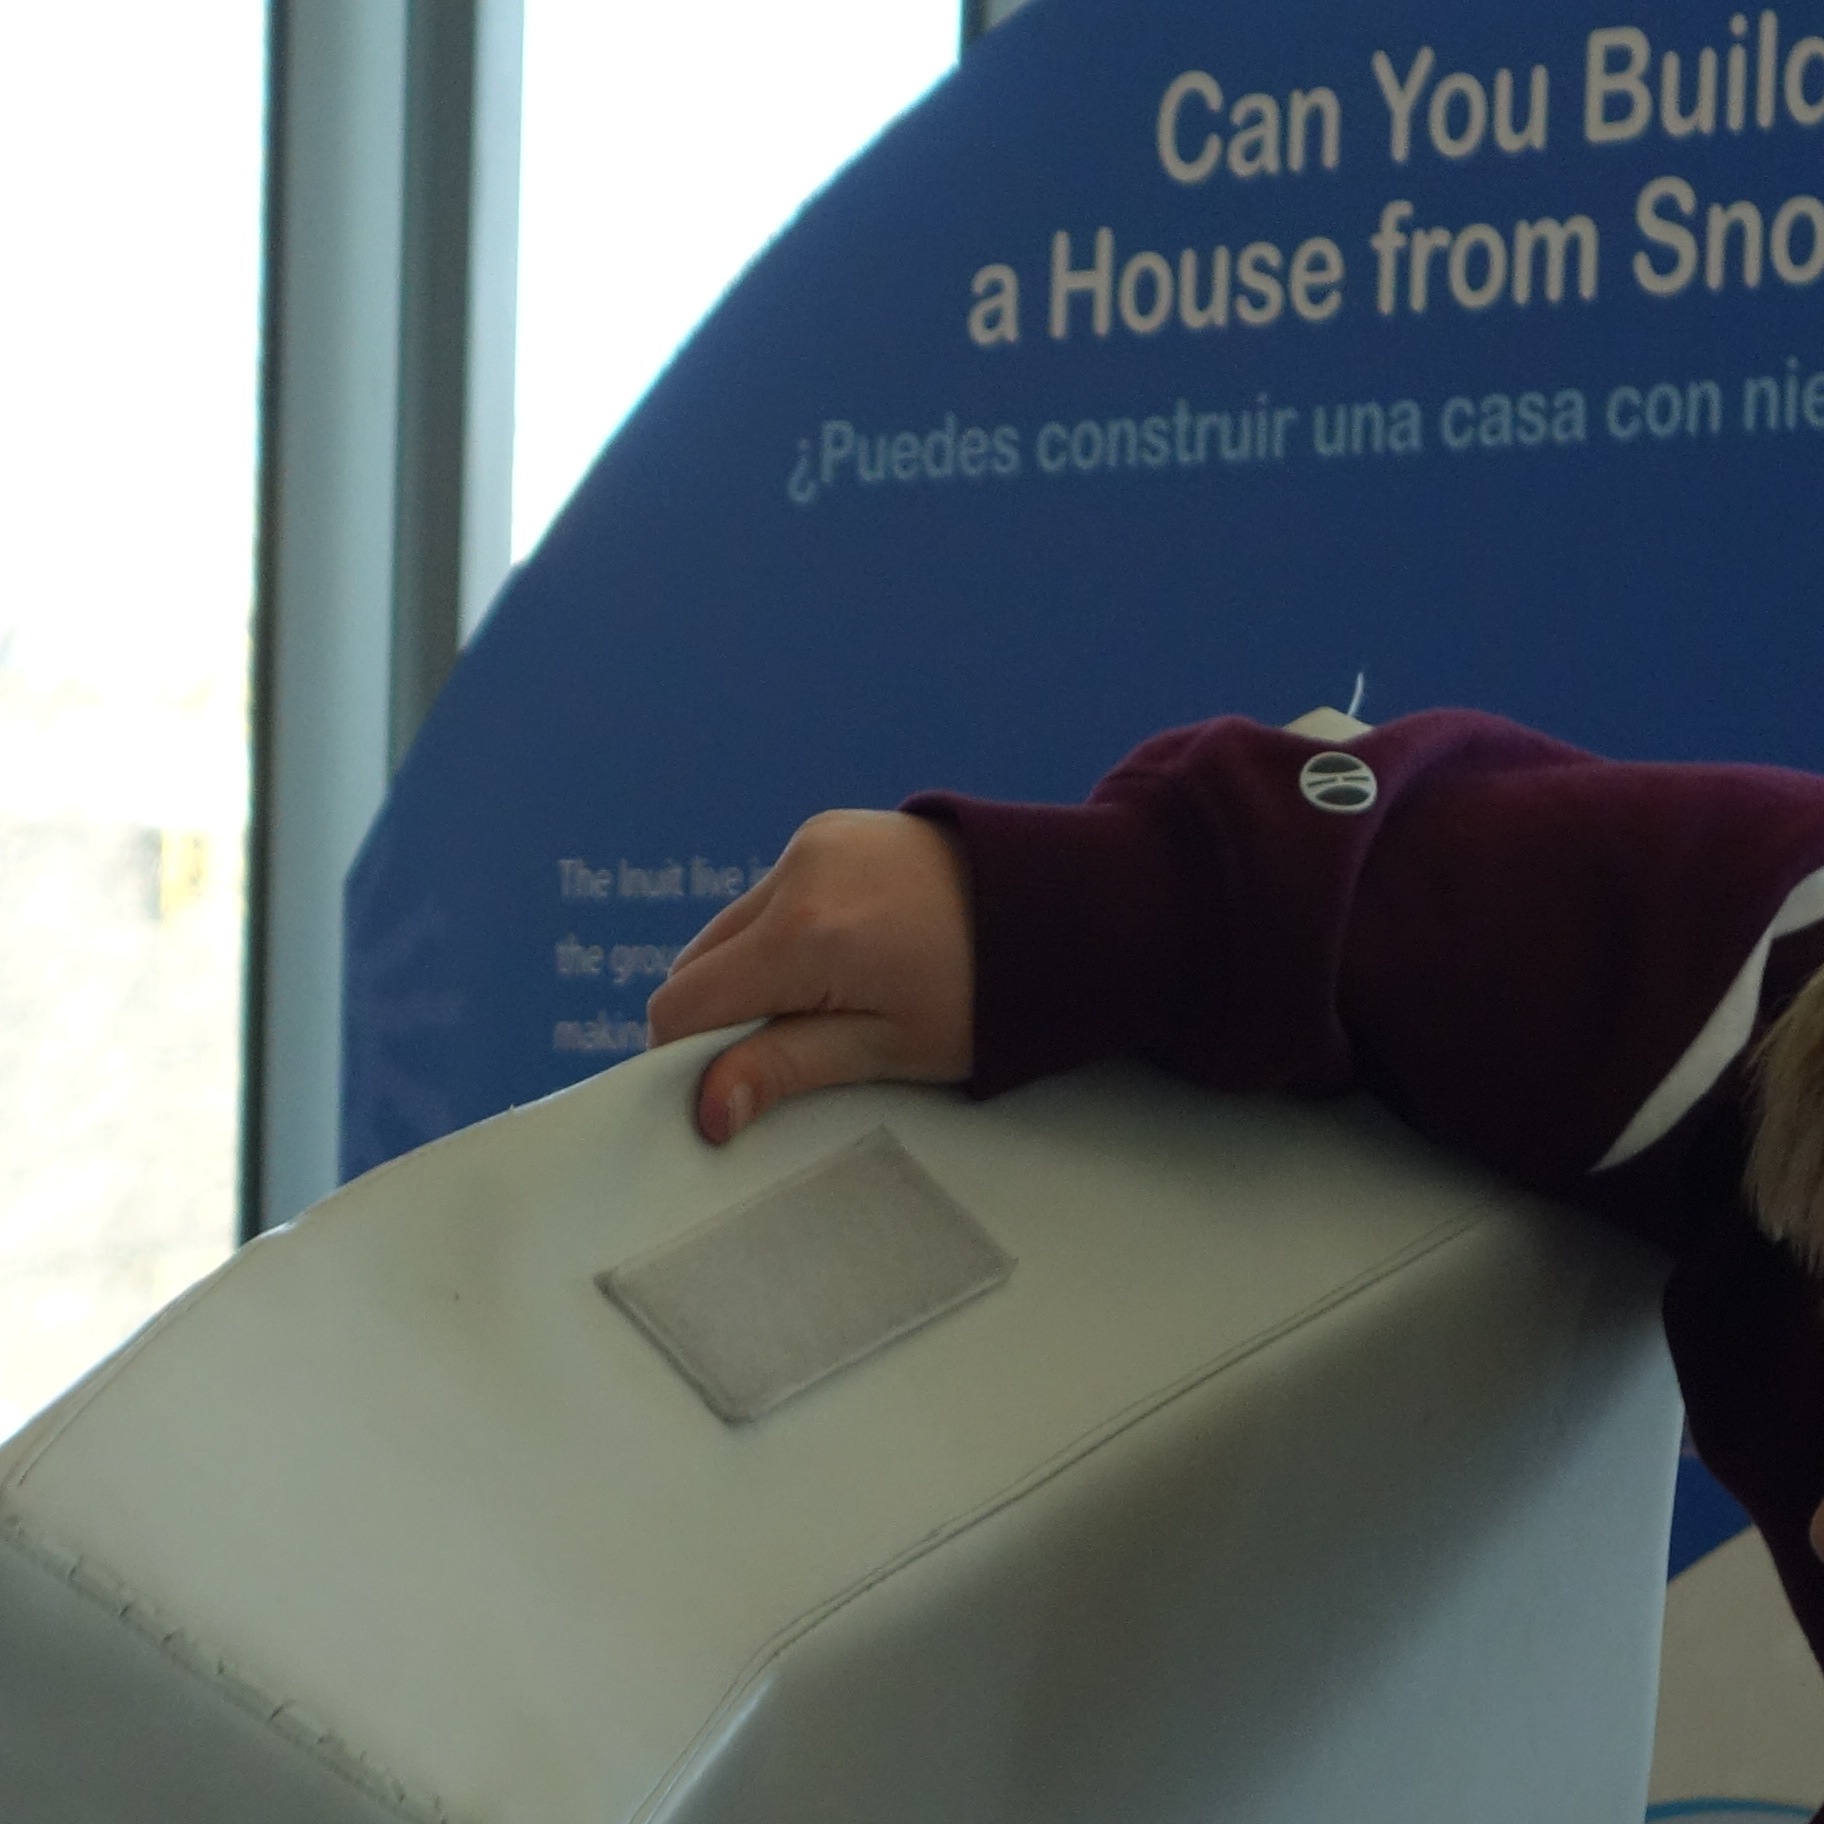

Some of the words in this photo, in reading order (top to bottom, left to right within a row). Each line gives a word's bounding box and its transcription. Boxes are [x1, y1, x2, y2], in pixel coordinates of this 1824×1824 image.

[1156, 69, 1342, 183] Can
[1371, 44, 1550, 163] You
[967, 262, 1020, 346] a
[1047, 225, 1345, 339] House
[1370, 199, 1599, 315] from
[787, 409, 1021, 503] ¿Puedes
[1036, 391, 1298, 473] construir
[1312, 397, 1424, 457] una
[1439, 387, 1589, 452] casa
[1605, 377, 1723, 441] con
